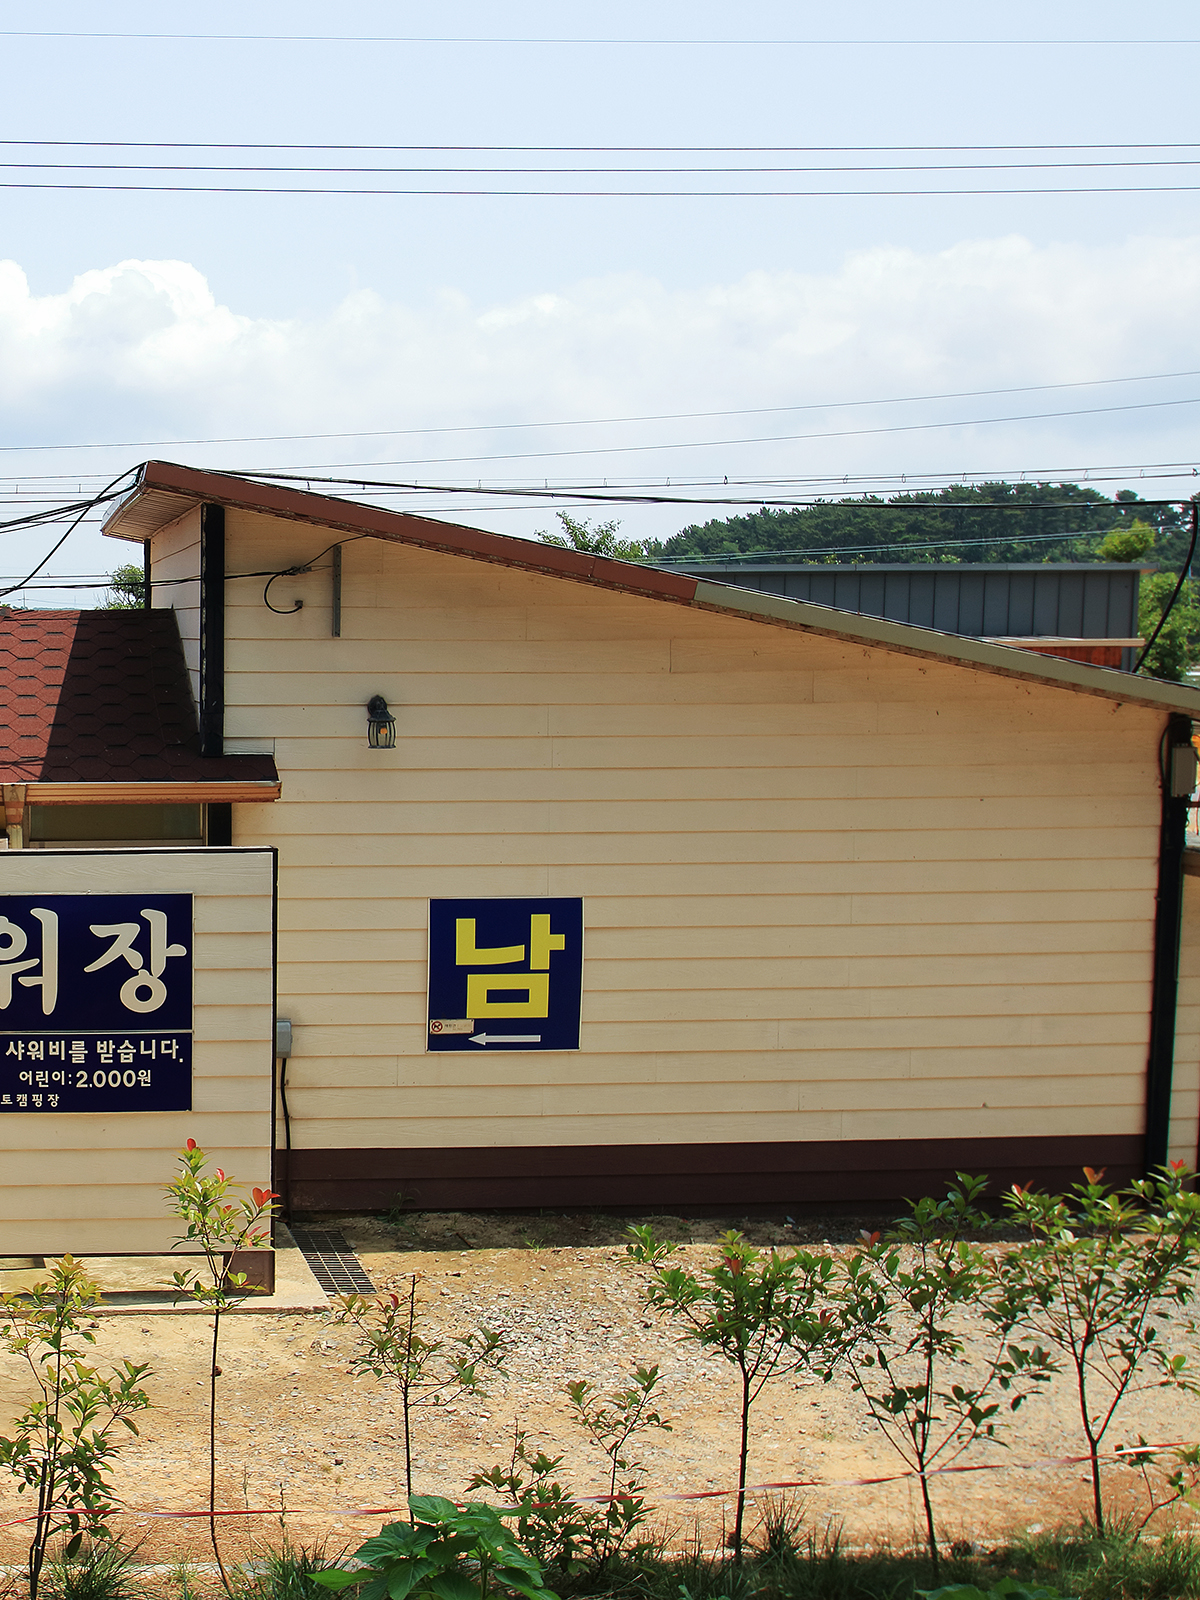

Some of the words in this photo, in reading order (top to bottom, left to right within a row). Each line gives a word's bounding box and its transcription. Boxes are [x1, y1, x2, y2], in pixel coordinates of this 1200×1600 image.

[455, 913, 565, 1019] 남
[5, 1040, 88, 1064] 샤워비를
[96, 1039, 184, 1063] 받습니다.
